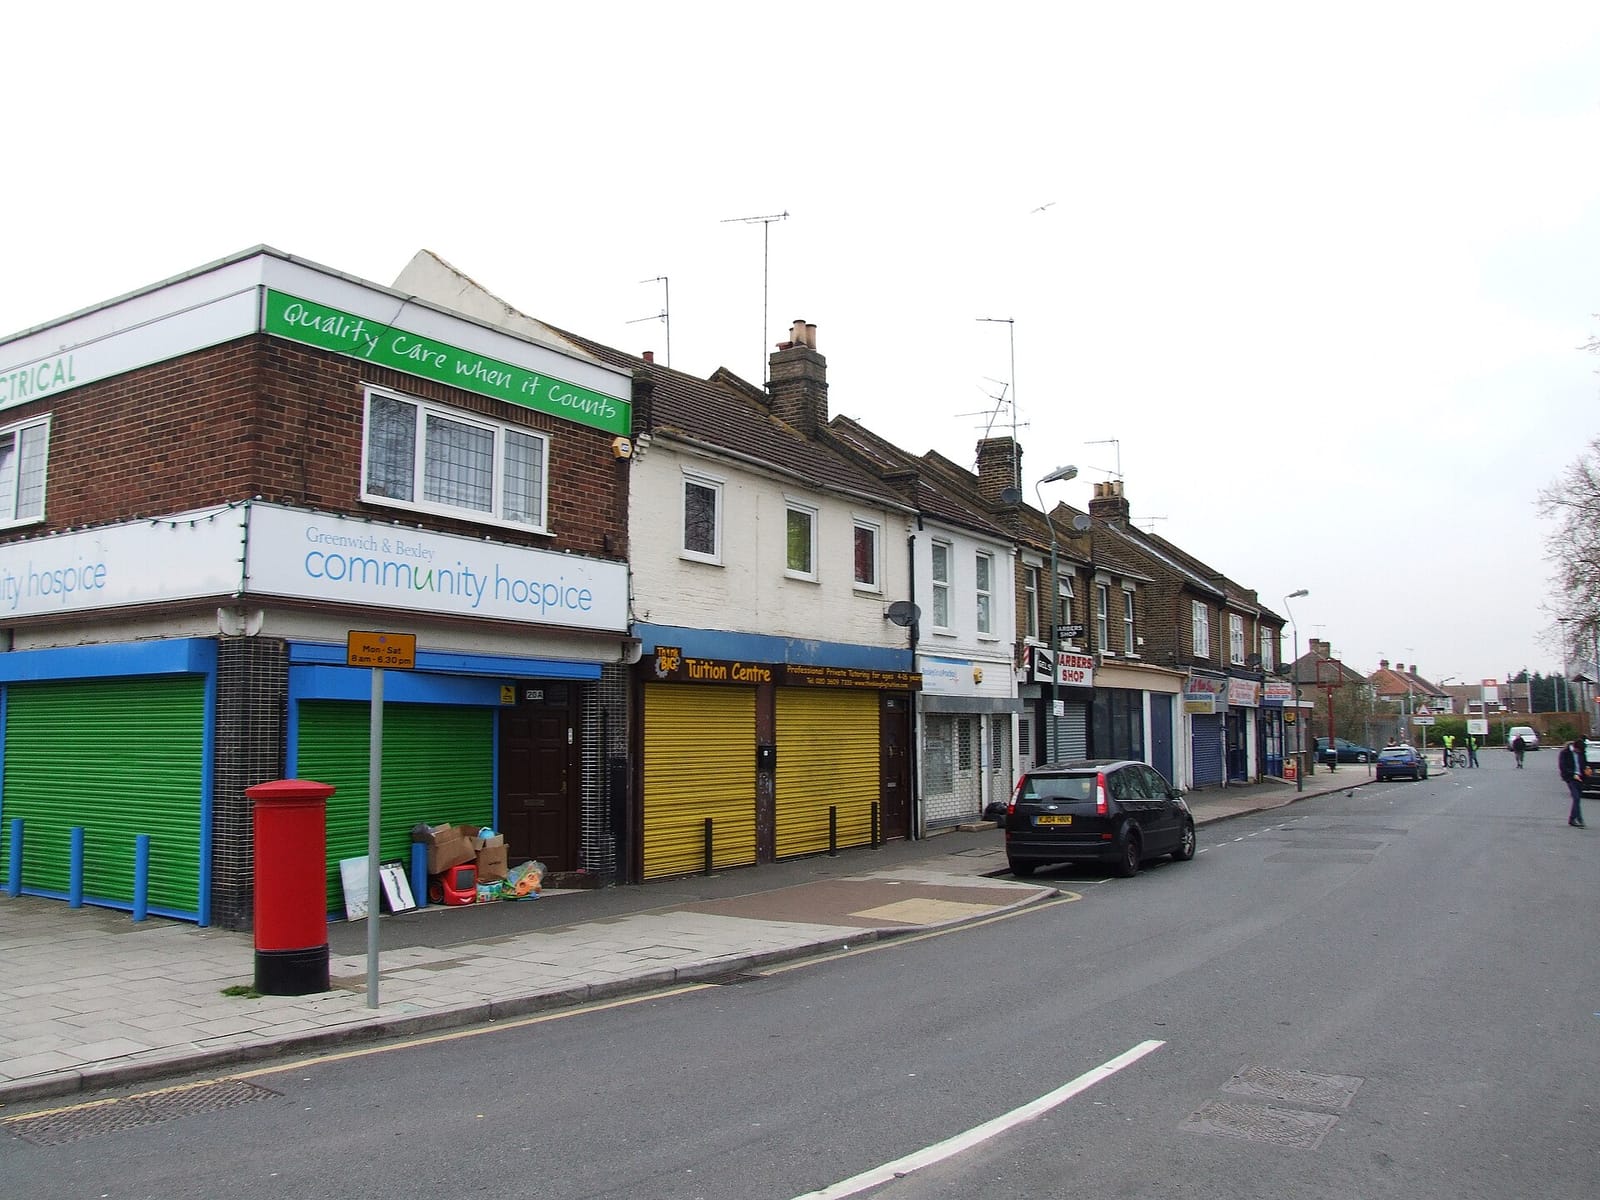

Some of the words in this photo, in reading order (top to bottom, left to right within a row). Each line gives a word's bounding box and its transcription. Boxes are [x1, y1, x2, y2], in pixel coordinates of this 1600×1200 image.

[283, 303, 379, 358] Quality
[391, 336, 448, 369] Care
[455, 360, 512, 389] when
[521, 376, 541, 396] it
[547, 384, 617, 419] Counts
[305, 526, 378, 552] Greenwich
[381, 537, 393, 554] &
[395, 540, 435, 563] Bexley
[0, 566, 24, 610] ity
[27, 555, 107, 604] hospice
[305, 550, 488, 608] community
[494, 562, 593, 616] hospice
[362, 645, 380, 653] Mon
[386, 646, 401, 655] Sat
[1057, 654, 1092, 669] ARBERS
[685, 658, 727, 680] Tuition
[731, 662, 771, 682] Centre
[786, 664, 824, 675] Professional
[826, 667, 847, 677] Private
[848, 669, 871, 680] Tutoring
[871, 671, 880, 679] for
[1062, 669, 1085, 683] SHOP
